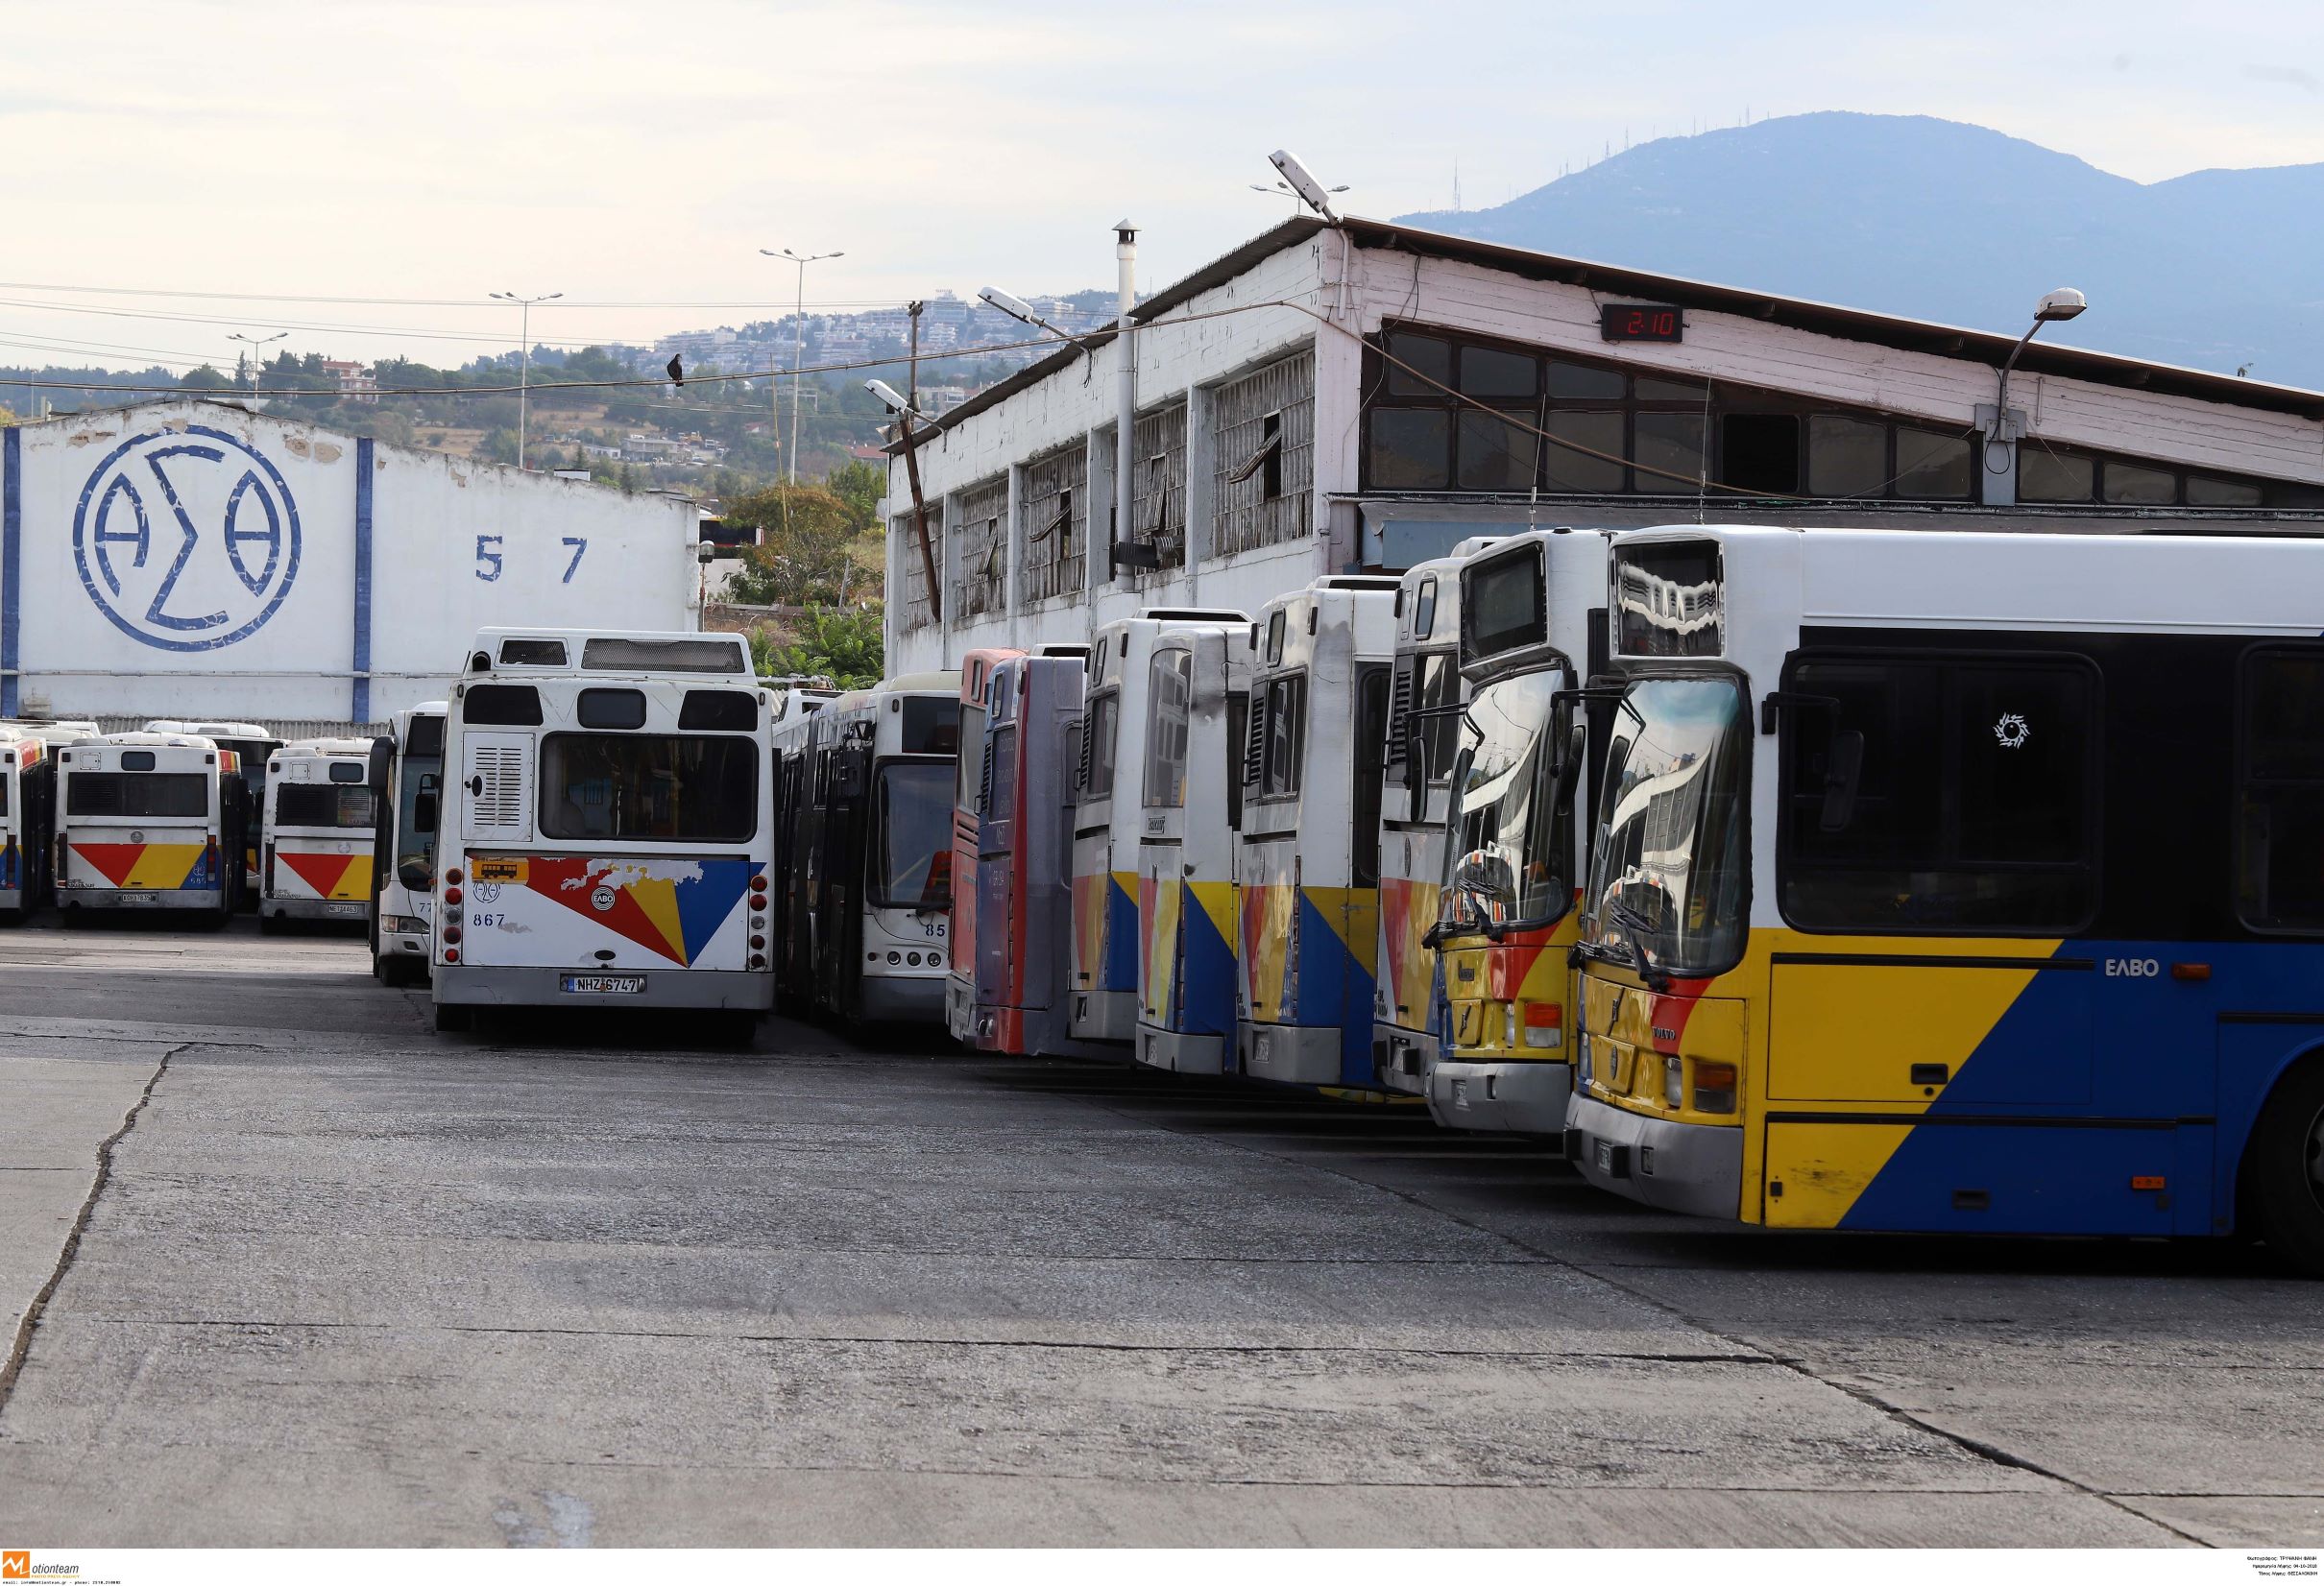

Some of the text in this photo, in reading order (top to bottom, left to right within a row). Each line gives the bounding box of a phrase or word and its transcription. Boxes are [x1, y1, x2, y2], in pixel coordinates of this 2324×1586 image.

[476, 535, 588, 584] 5 7
[473, 914, 505, 926] 867
[926, 924, 946, 937] 85
[2105, 958, 2160, 977] ΕΛΒΟ
[605, 979, 637, 992] 6747
[1652, 1026, 1676, 1040] VOLVO
